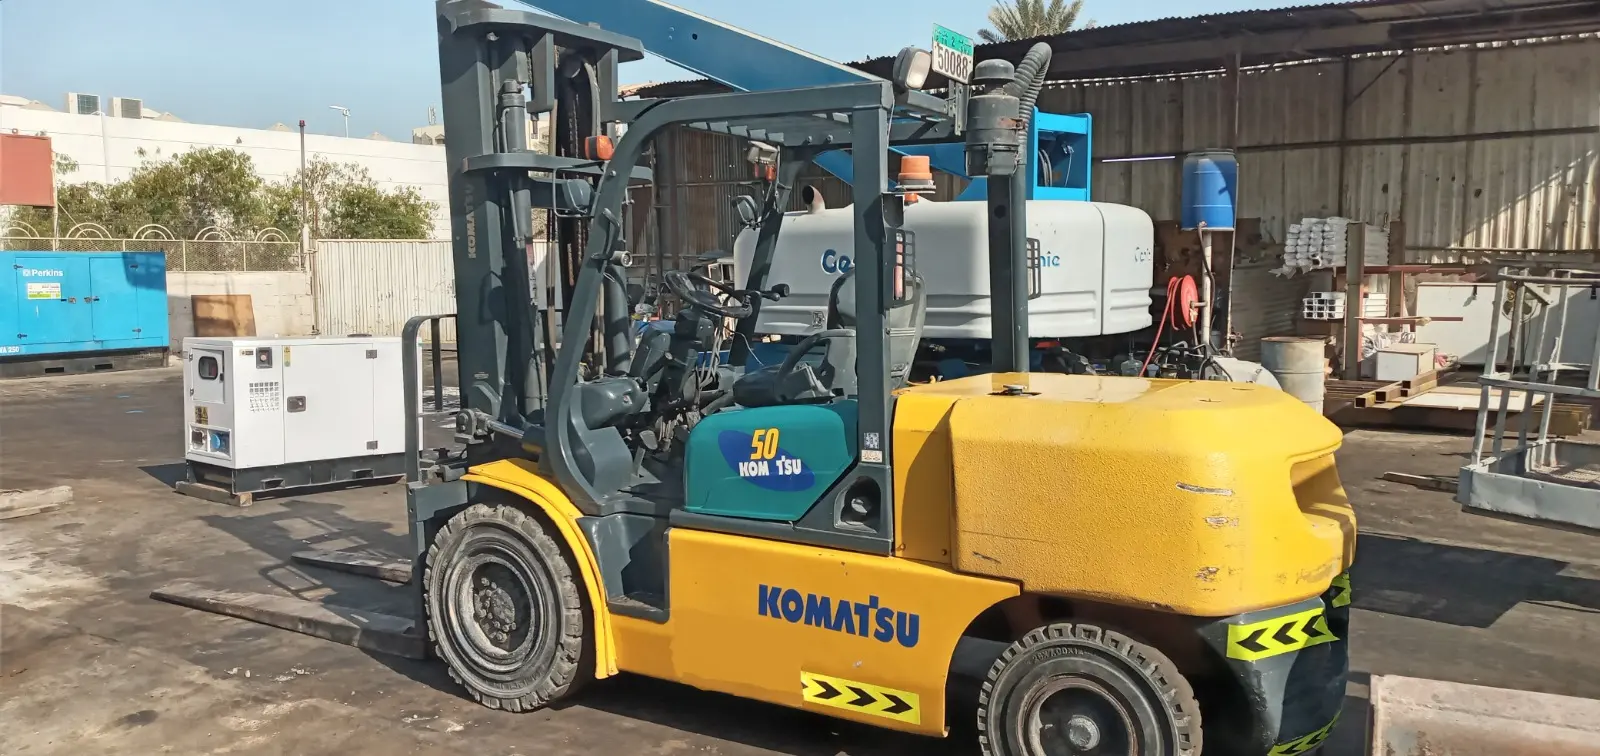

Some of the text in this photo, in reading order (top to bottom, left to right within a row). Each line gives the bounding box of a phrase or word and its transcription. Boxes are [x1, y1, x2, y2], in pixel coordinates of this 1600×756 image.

[937, 43, 968, 80] 50088
[464, 184, 476, 259] KOMATSU
[31, 268, 64, 277] Perkins
[750, 427, 780, 460] 50
[739, 455, 802, 477] KOMTSU
[758, 584, 920, 648] KOMATSU
